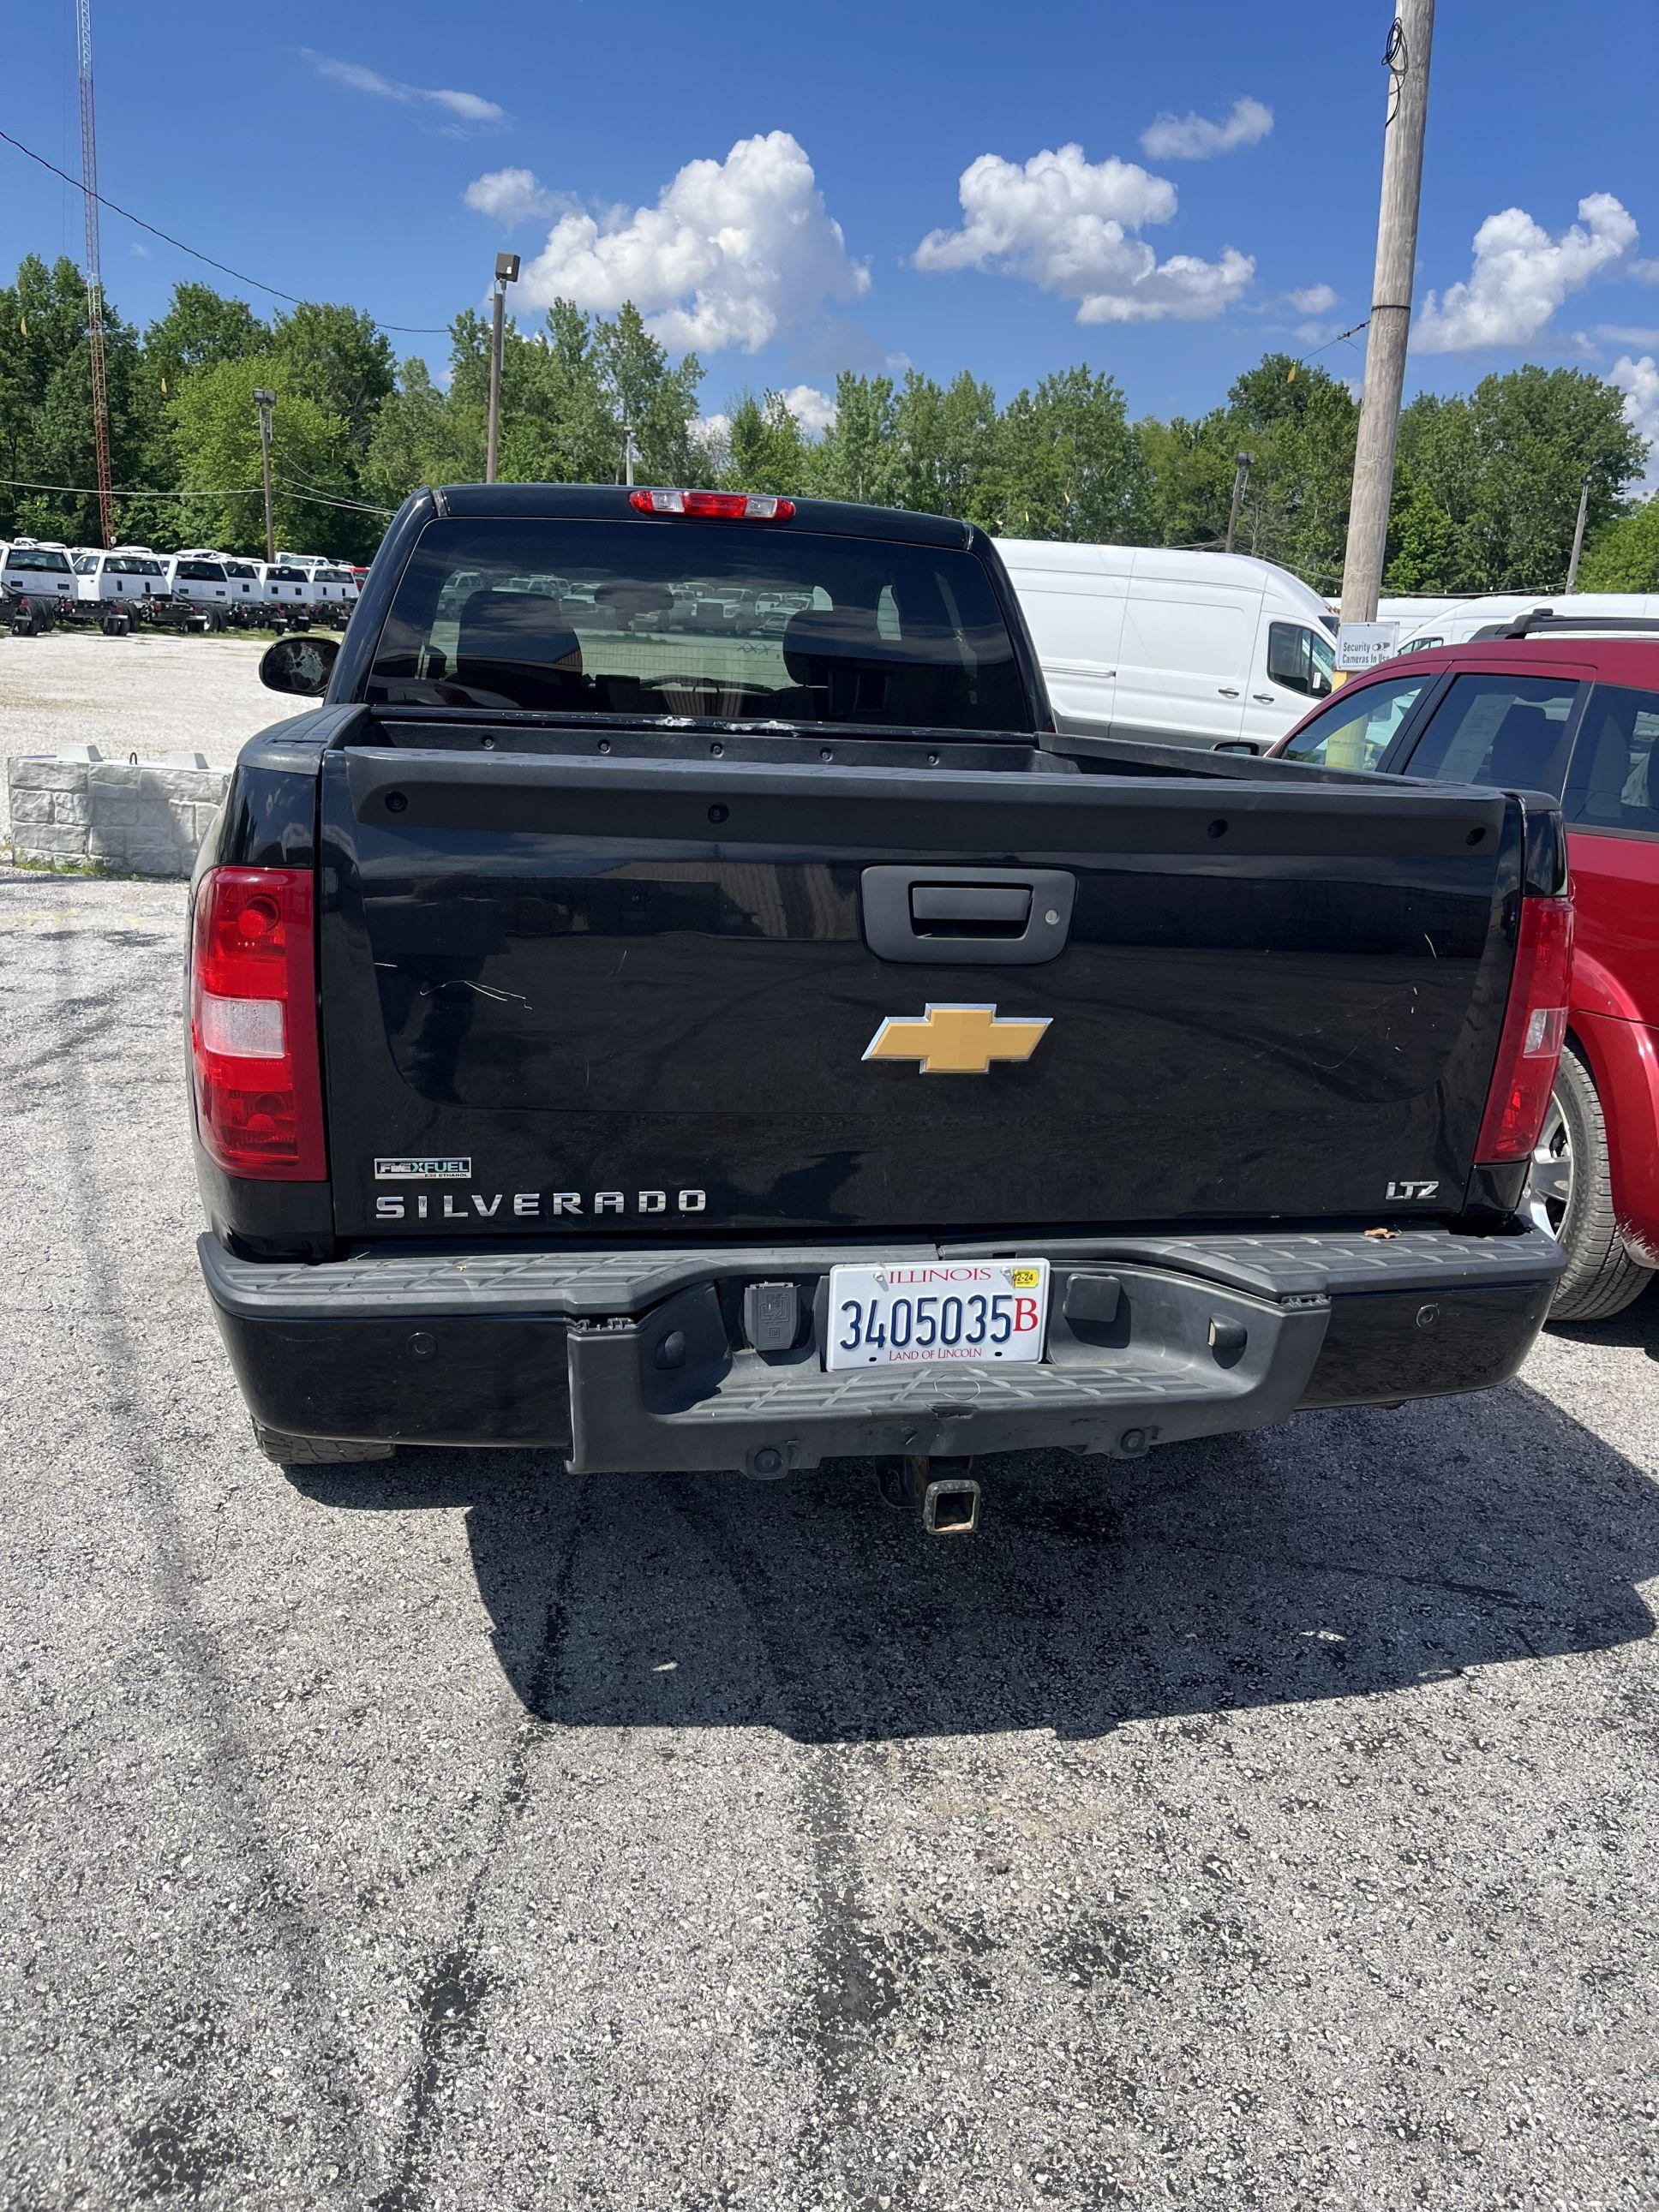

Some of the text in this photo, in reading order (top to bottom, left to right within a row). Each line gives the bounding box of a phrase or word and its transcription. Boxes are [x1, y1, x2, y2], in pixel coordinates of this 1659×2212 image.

[1343, 642, 1370, 653] Security
[1342, 654, 1369, 664] Cameras
[1370, 654, 1377, 663] In
[1386, 1181, 1440, 1200] LTZ
[375, 1189, 706, 1218] SILVERADO
[889, 1267, 991, 1284] ILLINOIS
[839, 1294, 1039, 1350] 3405035 B
